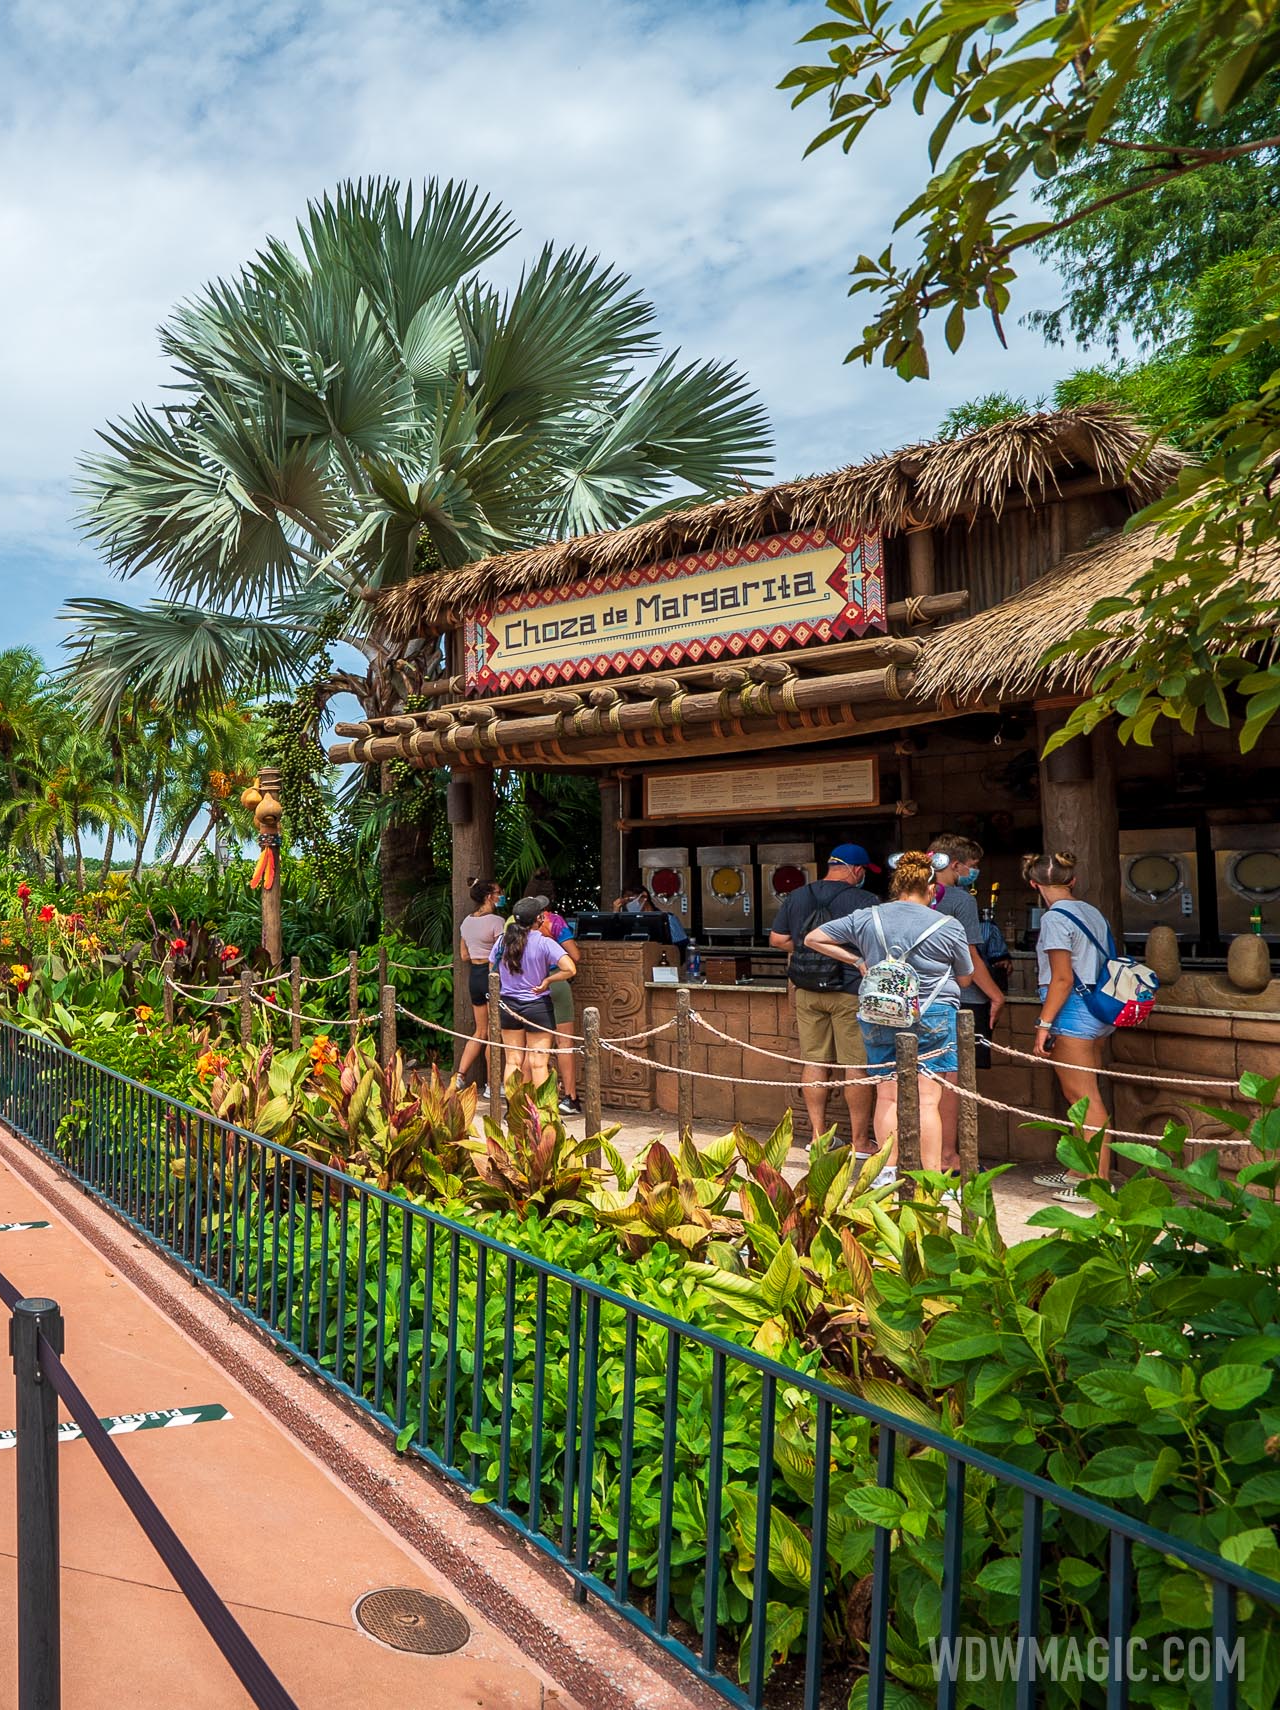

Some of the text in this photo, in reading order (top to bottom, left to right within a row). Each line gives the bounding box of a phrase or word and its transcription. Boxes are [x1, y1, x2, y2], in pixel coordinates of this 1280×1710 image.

[505, 571, 816, 650] Choza de Margarita
[108, 1408, 183, 1425] PLEASE
